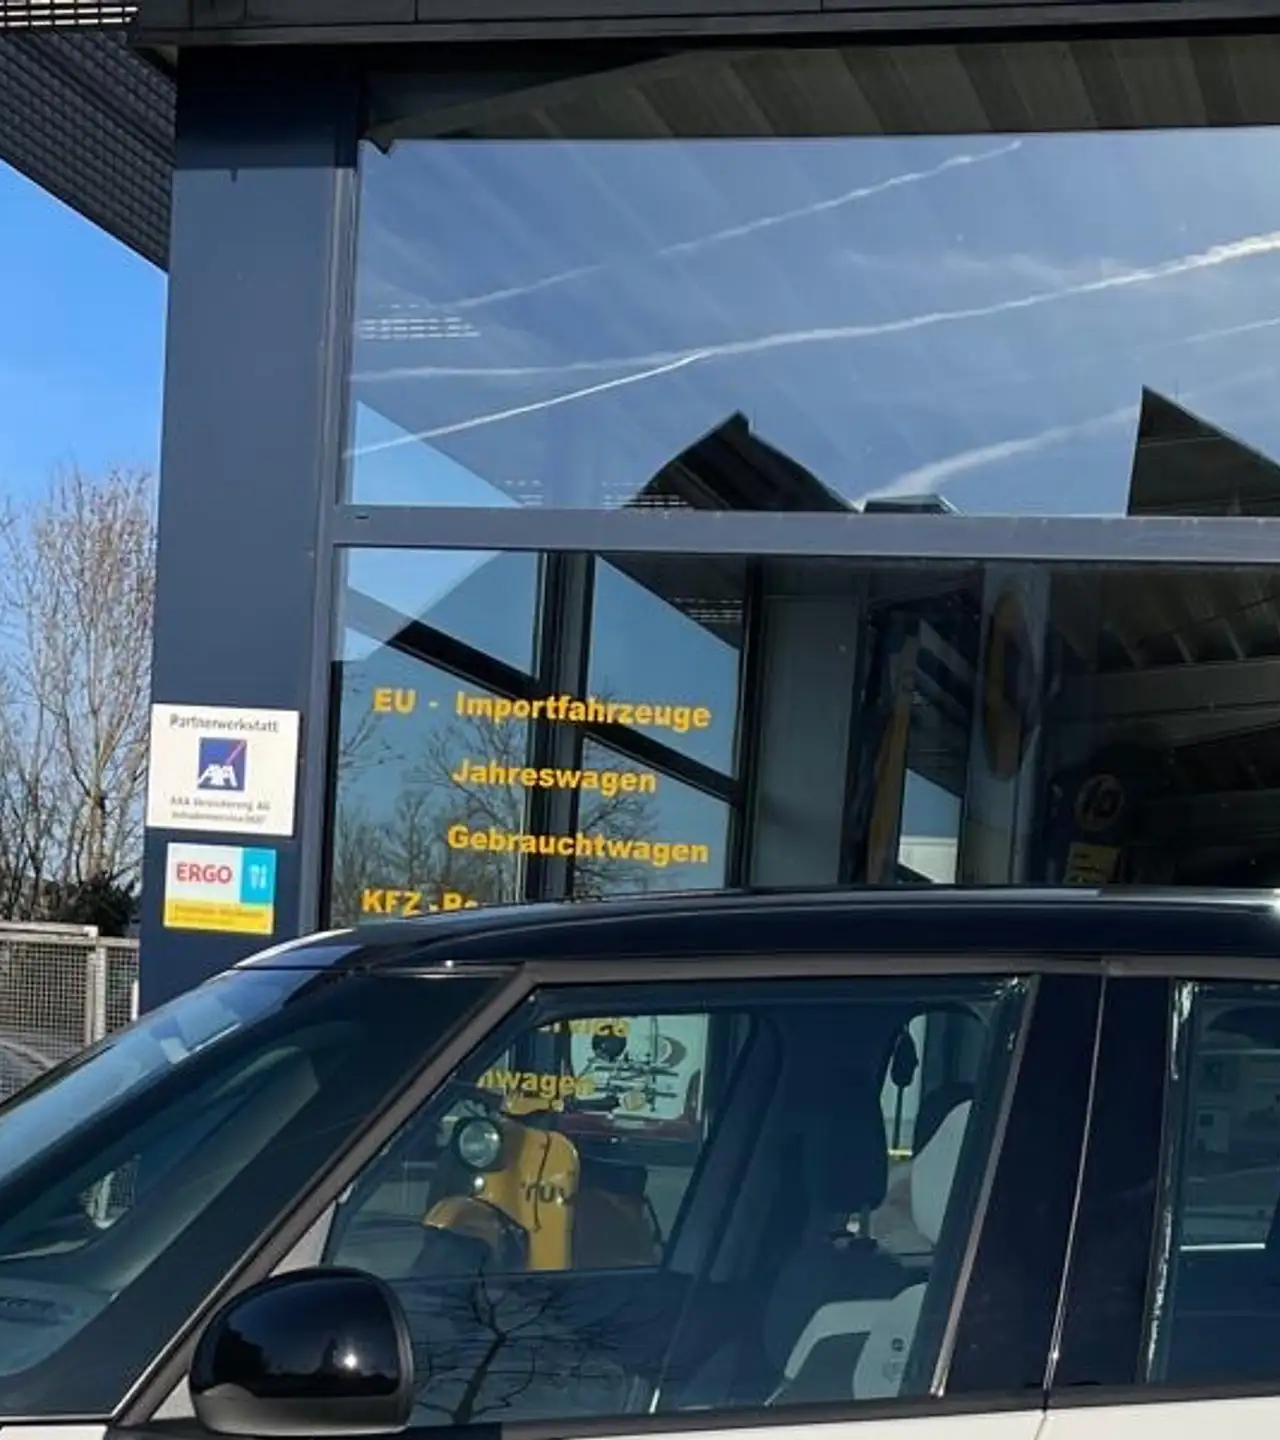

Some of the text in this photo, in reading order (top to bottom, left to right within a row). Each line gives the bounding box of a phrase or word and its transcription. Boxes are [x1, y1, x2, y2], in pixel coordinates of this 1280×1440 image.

[170, 714, 280, 733] Partnerwerkstatt
[373, 687, 417, 714] EU
[456, 690, 712, 733] Importfahrzeuge
[197, 763, 239, 788] AXA
[451, 759, 658, 798] Jahreswagen
[447, 824, 709, 867] Gebrauchtwagen
[176, 862, 234, 884] ERGO
